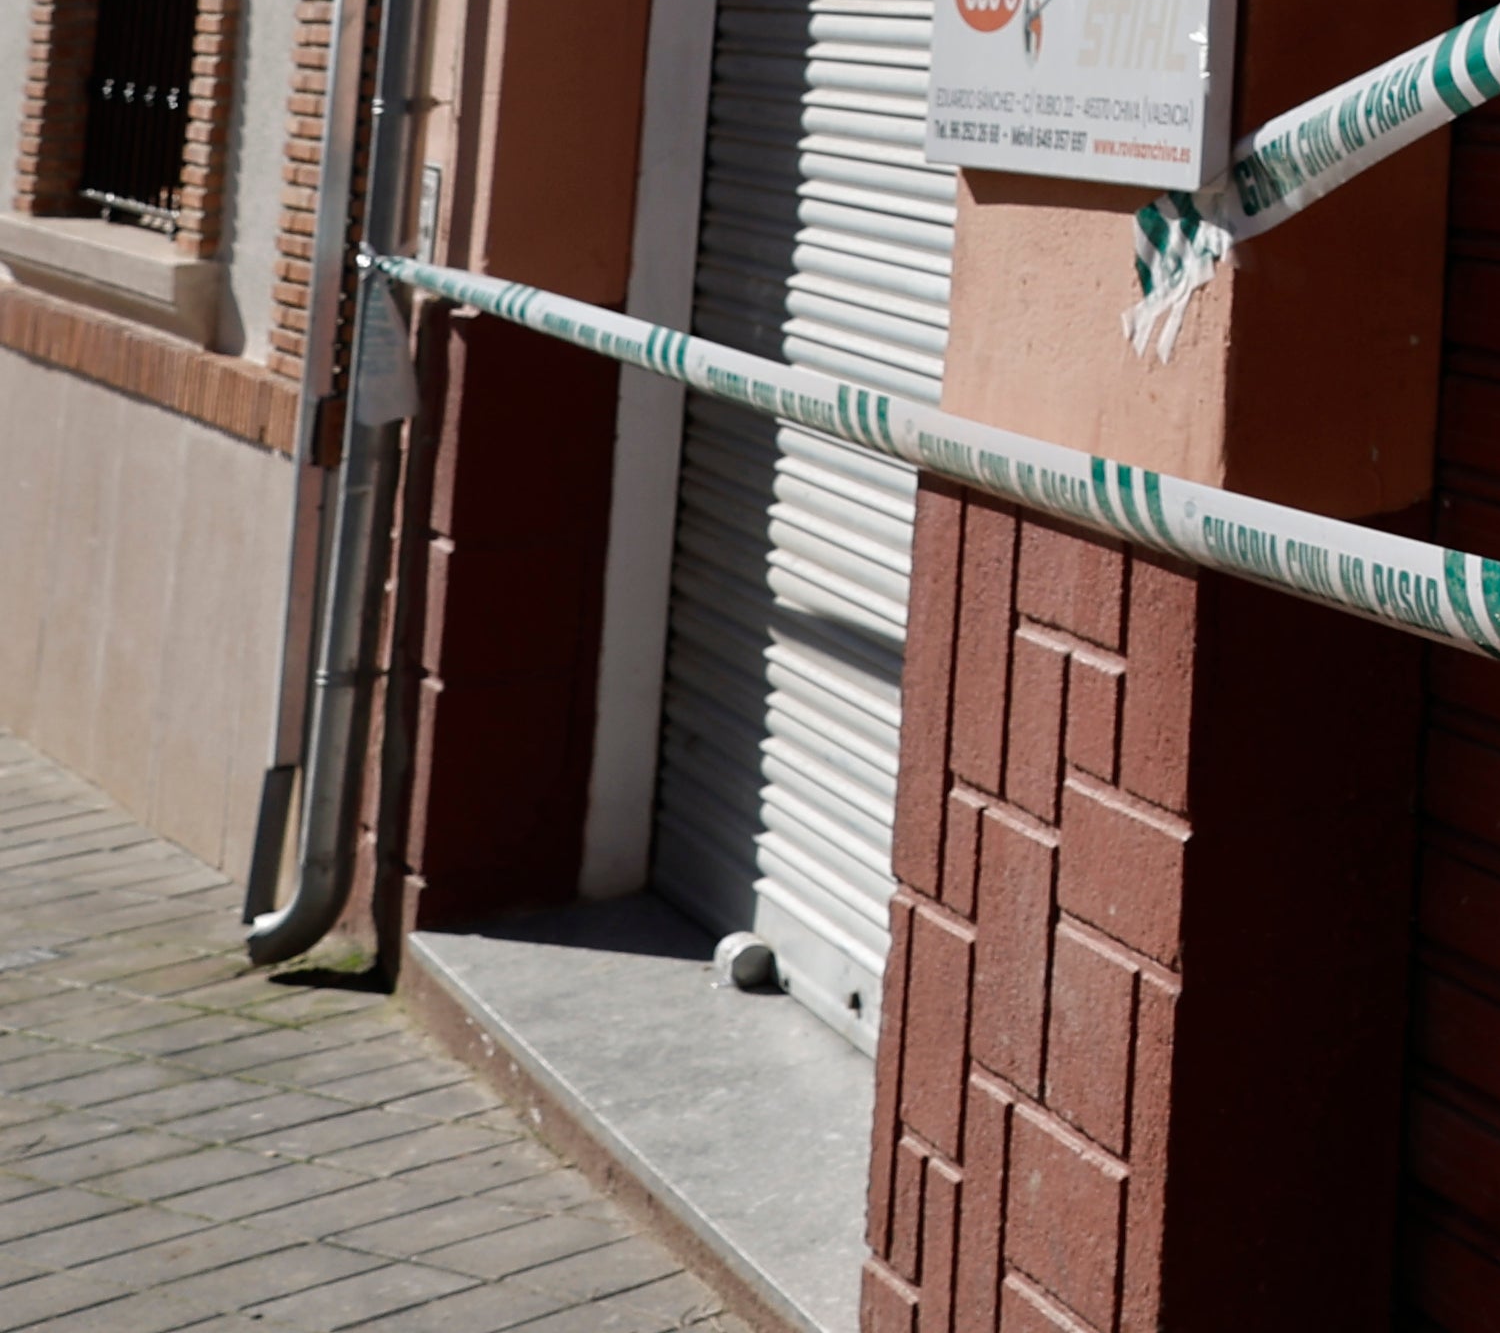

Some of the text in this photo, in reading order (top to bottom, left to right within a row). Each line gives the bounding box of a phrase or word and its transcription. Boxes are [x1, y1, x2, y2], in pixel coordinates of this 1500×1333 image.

[1364, 54, 1429, 140] PASAR
[1203, 515, 1286, 584] GUARDIA
[1286, 538, 1343, 604] CIVIL
[1339, 552, 1377, 614] NO
[1372, 562, 1450, 636] PASAR
